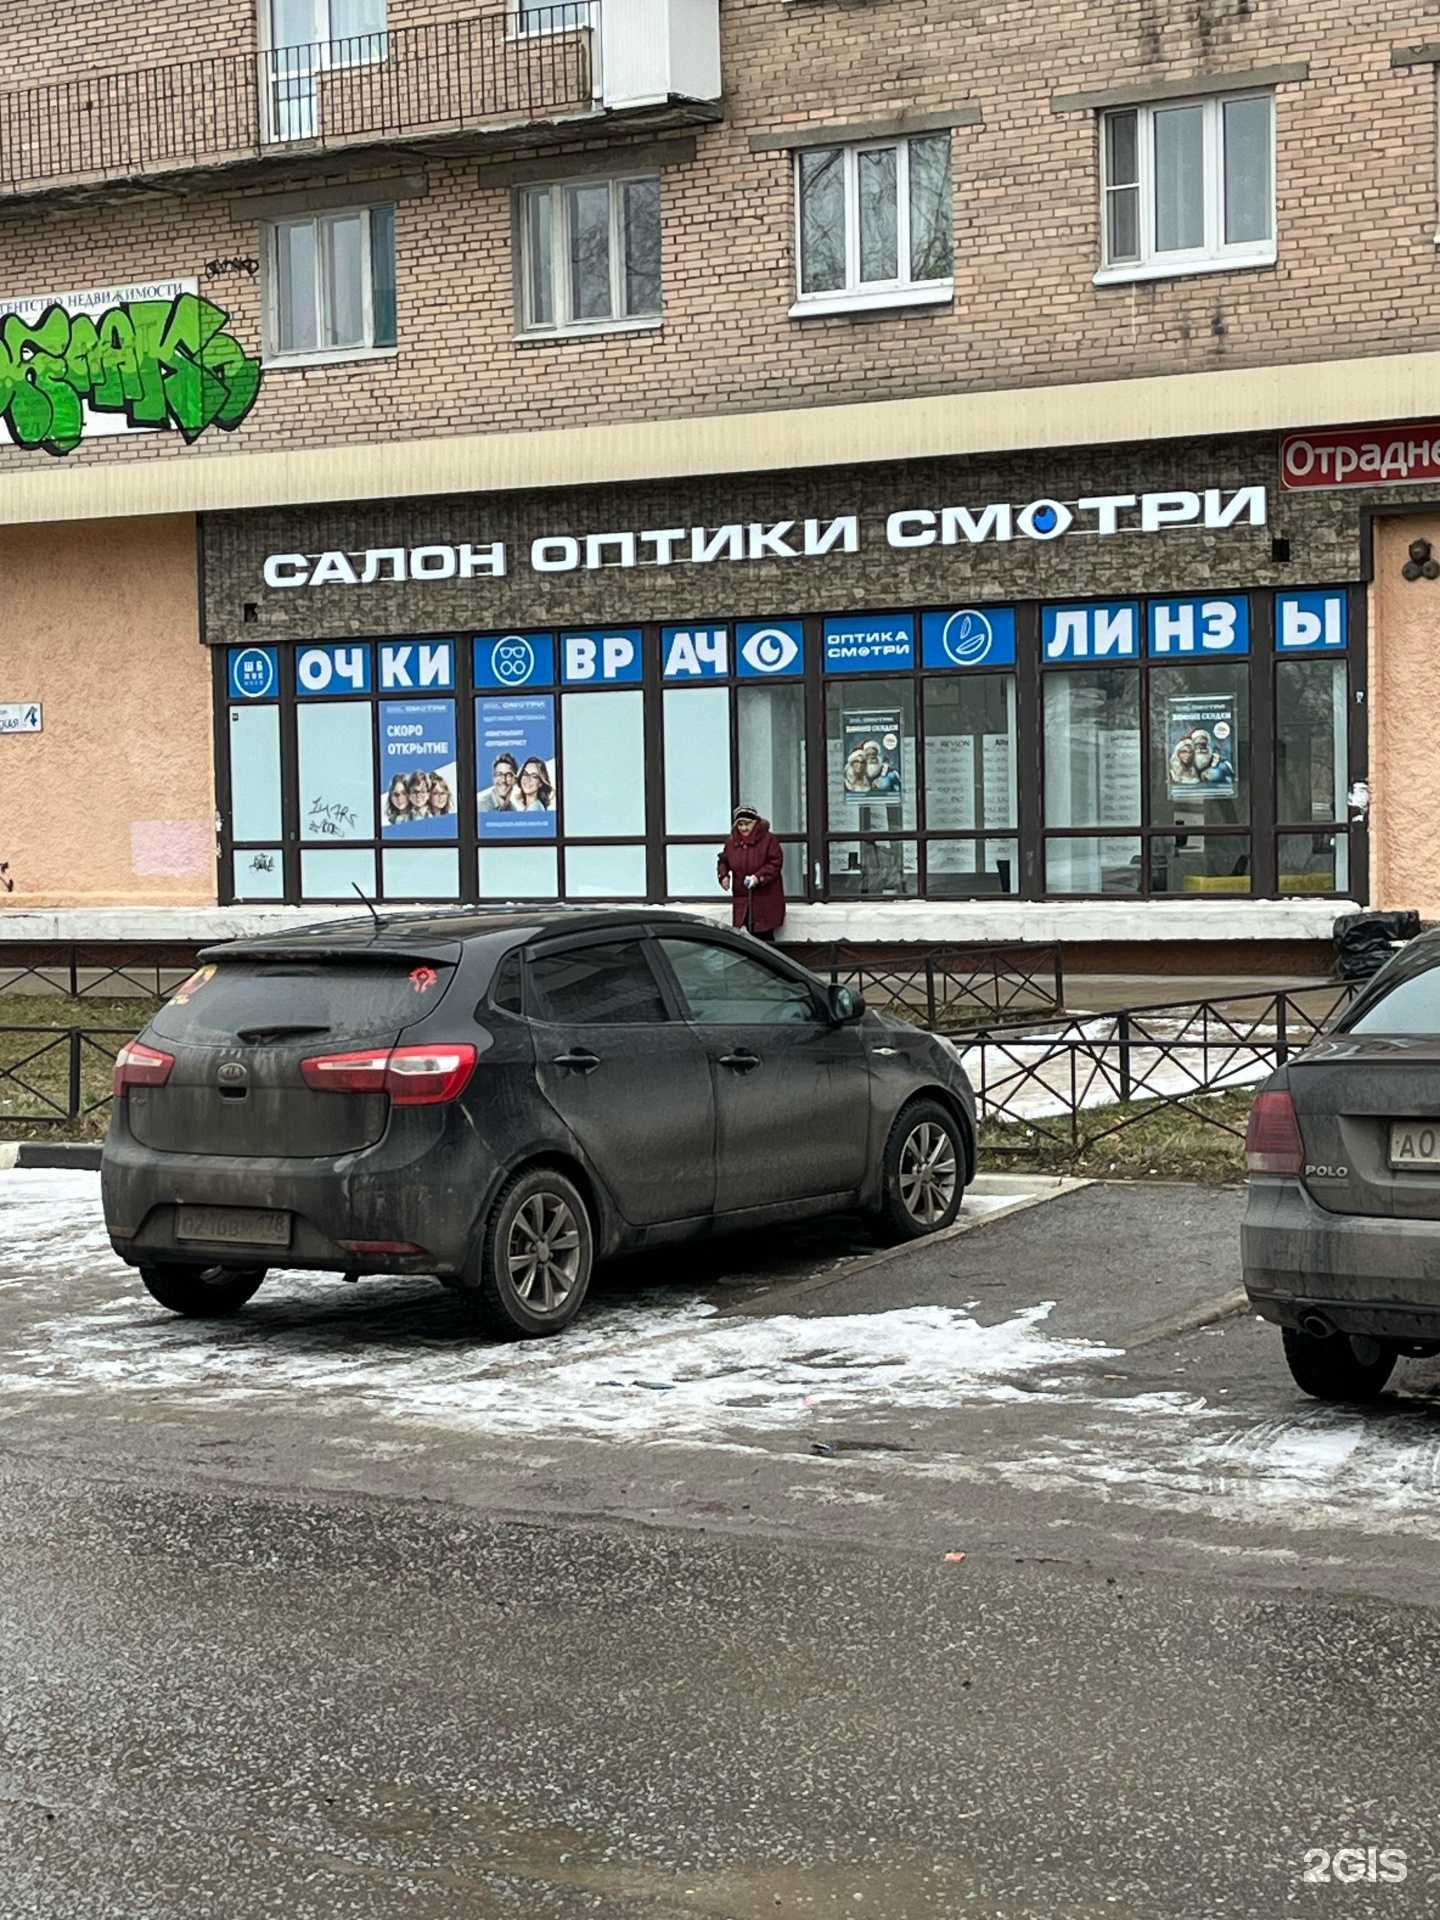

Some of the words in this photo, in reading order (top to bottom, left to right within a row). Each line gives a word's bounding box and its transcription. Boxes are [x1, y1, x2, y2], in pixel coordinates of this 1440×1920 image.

[263, 541, 506, 588] САЛОН
[531, 515, 859, 572] ОПТИКИ
[886, 486, 1266, 548] СМОТРИ
[827, 630, 910, 644] ОПТИКА
[827, 644, 911, 658] СМОТРИ
[299, 644, 450, 690] ОЧКИ
[566, 630, 728, 680] ВРАЧ
[387, 724, 423, 737] СКОРО
[387, 742, 449, 755] ОТКРЫТИЕ
[1305, 1165, 1348, 1177] POLO
